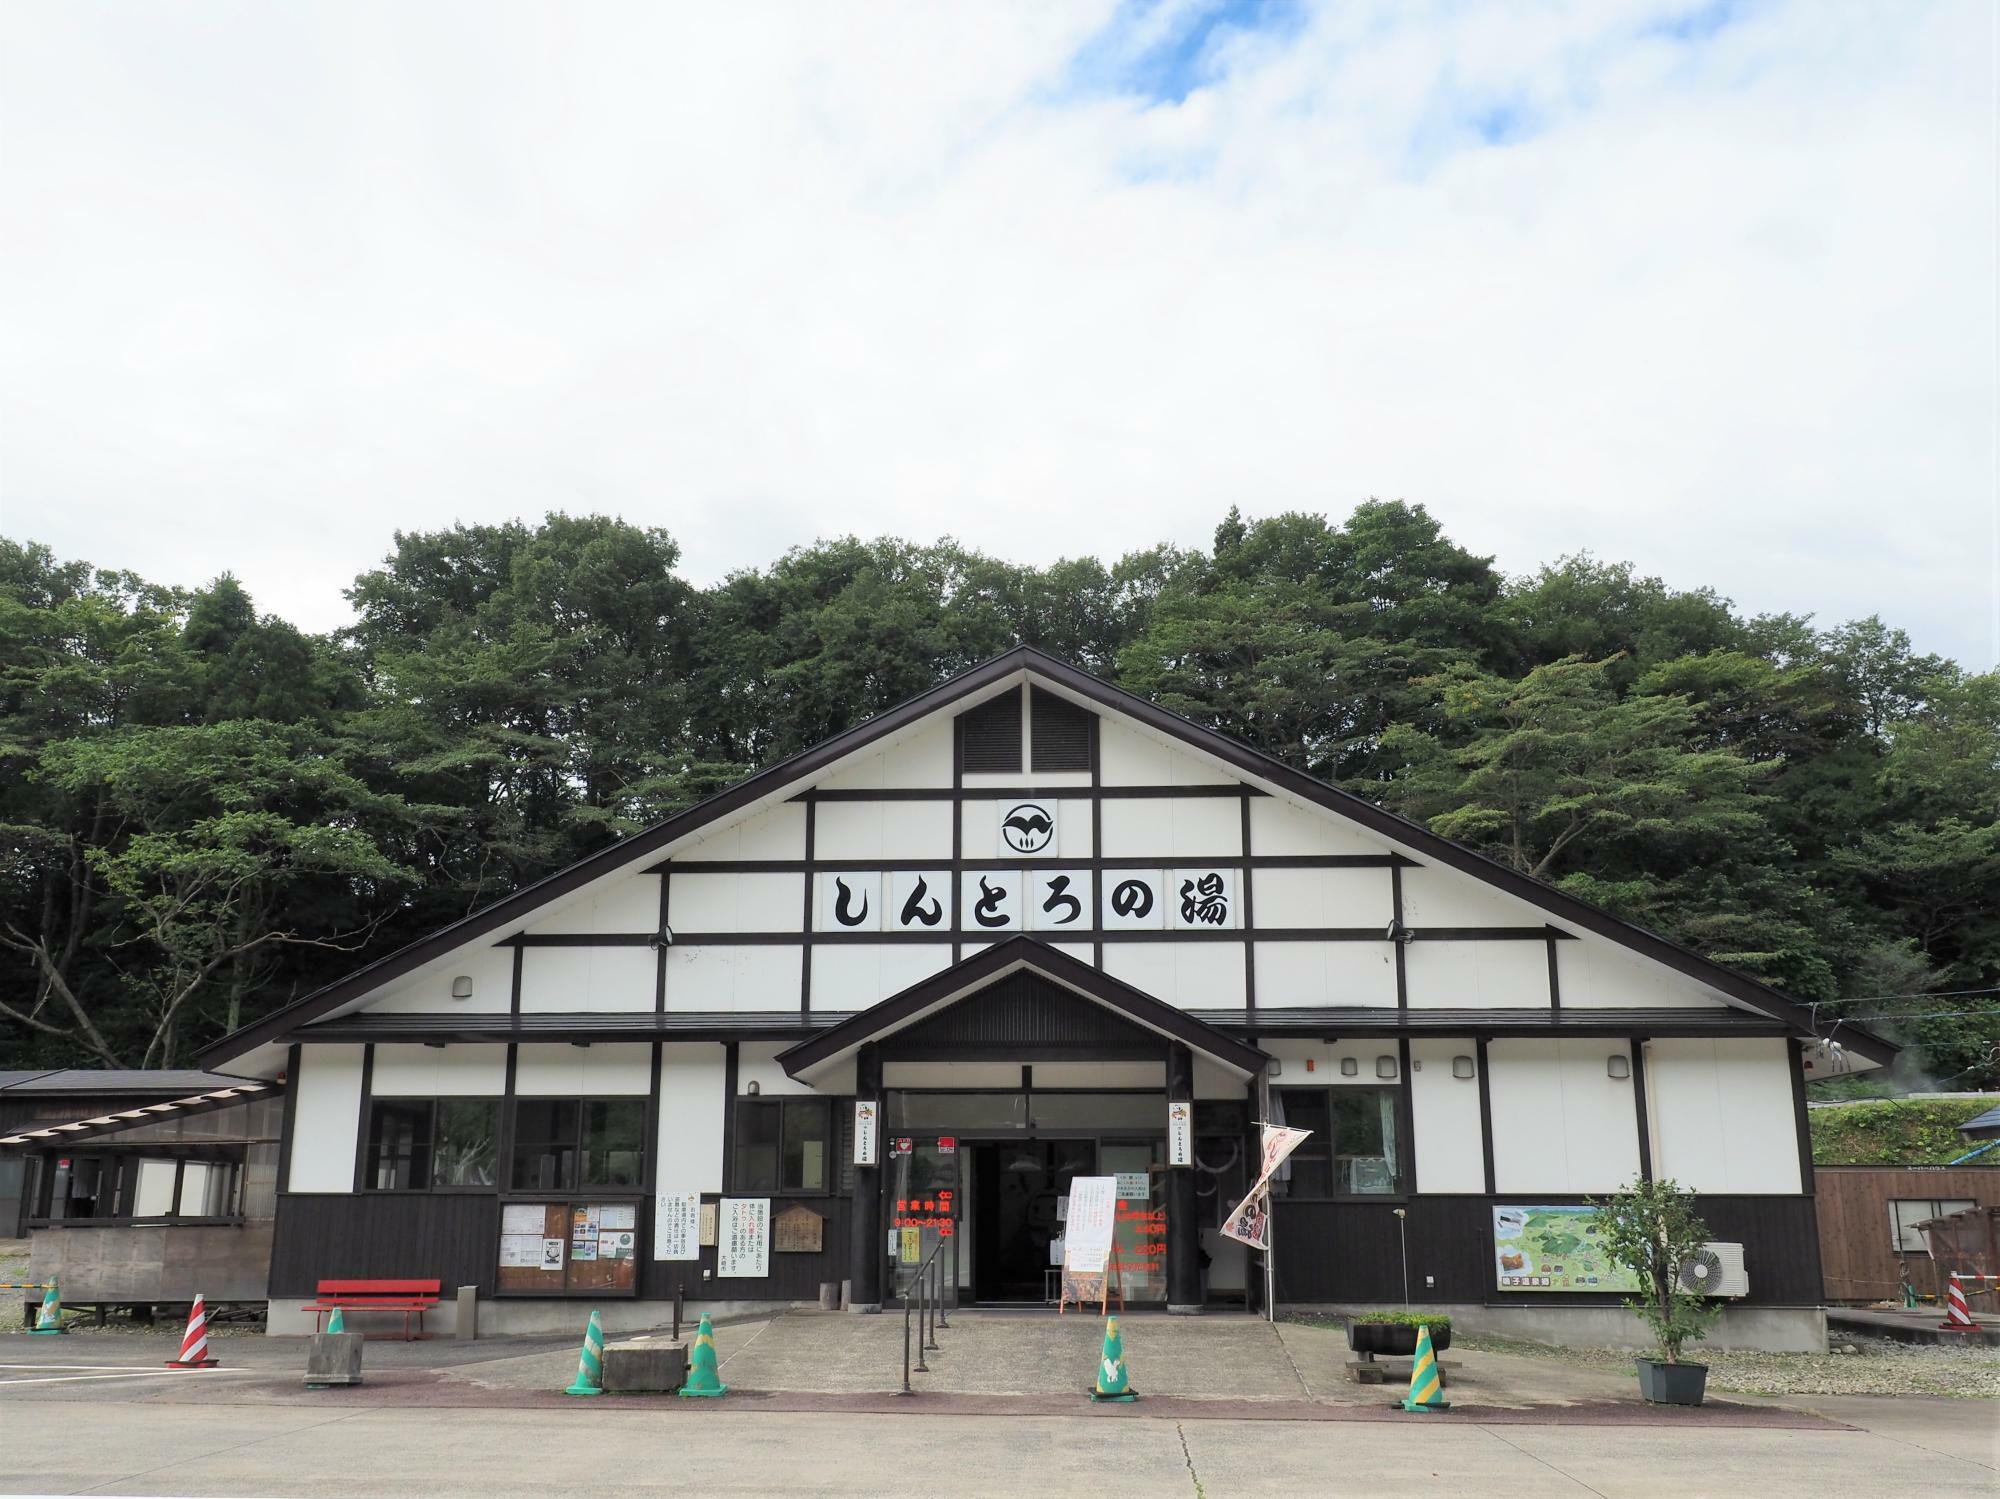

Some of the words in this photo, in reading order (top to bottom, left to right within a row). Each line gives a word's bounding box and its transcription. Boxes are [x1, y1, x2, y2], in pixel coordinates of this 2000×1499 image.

[835, 873, 1228, 927] しんとろの湯
[897, 1200, 950, 1211] 営業時間
